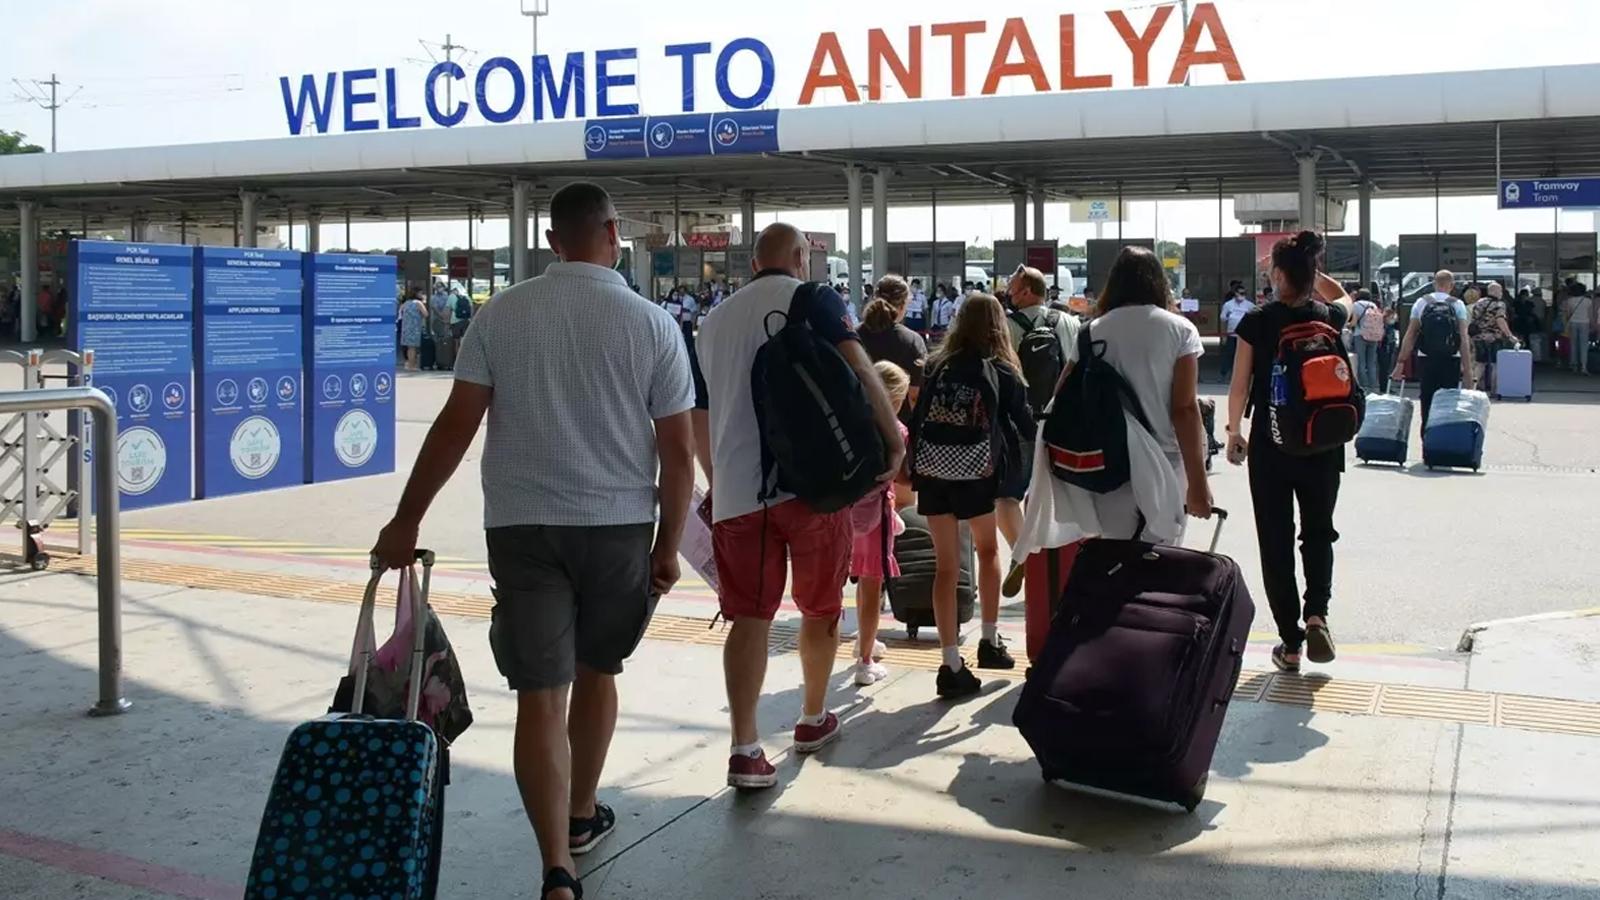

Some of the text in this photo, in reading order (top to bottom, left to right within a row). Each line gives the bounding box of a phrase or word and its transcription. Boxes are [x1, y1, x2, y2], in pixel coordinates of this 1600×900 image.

[280, 2, 1246, 135] WELCOME TO ANTALYA
[1533, 181, 1579, 192] Tramvay
[1533, 192, 1558, 202] Tram
[145, 312, 184, 320] YAPILACAKLAR
[83, 374, 92, 463] PLİS
